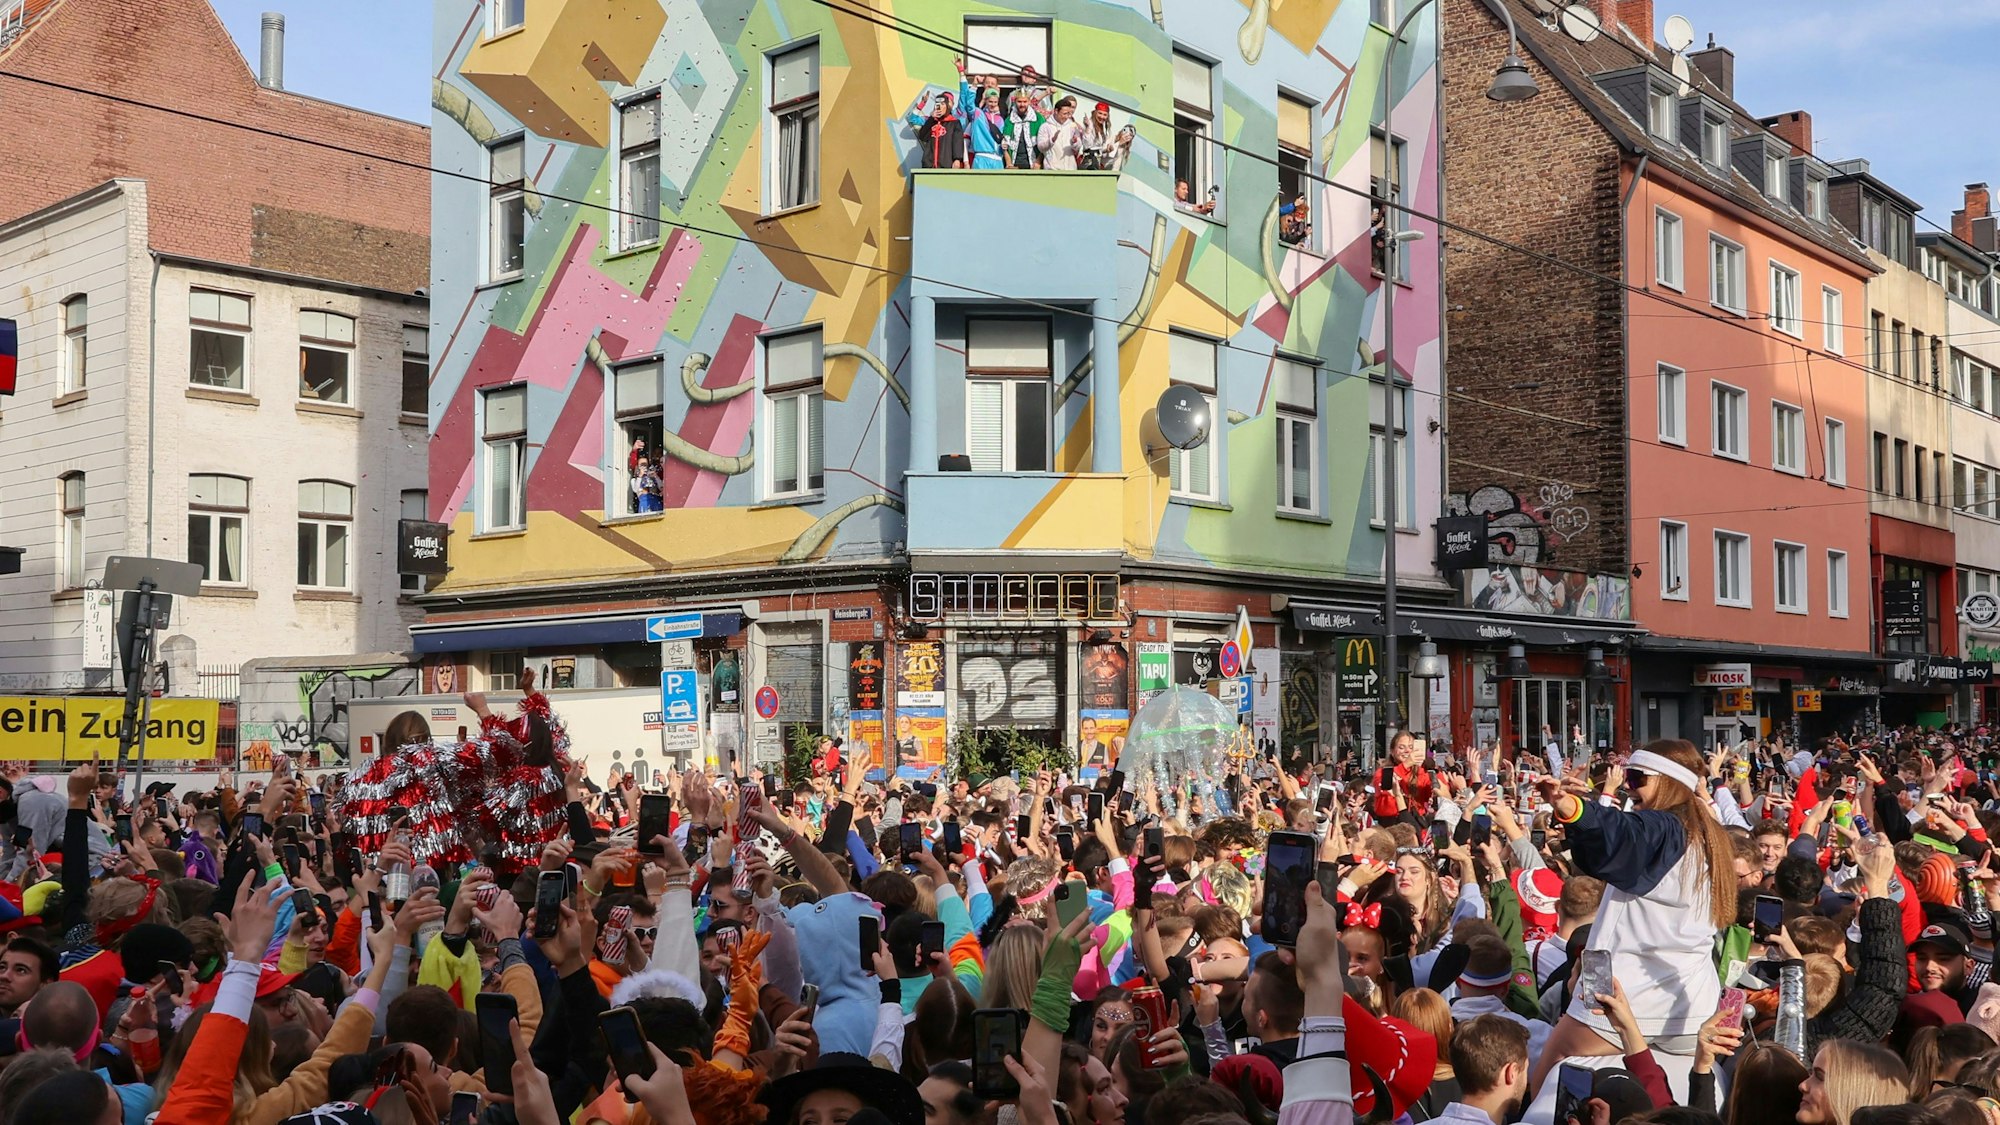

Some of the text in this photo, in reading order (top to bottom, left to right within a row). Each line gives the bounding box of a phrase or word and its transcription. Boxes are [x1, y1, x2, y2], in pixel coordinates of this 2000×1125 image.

[1174, 404, 1192, 412] TRIAX
[413, 536, 439, 549] Gaffel
[1446, 531, 1472, 543] Gaffel
[915, 579, 1117, 613] STIEFEL
[1310, 612, 1332, 628] Gaffel
[1140, 644, 1156, 652] READY
[1141, 663, 1168, 680] TABU
[1966, 666, 1989, 679] sky
[667, 674, 683, 695] P
[1709, 673, 1745, 684] KIOSK
[644, 713, 659, 722] TOI
